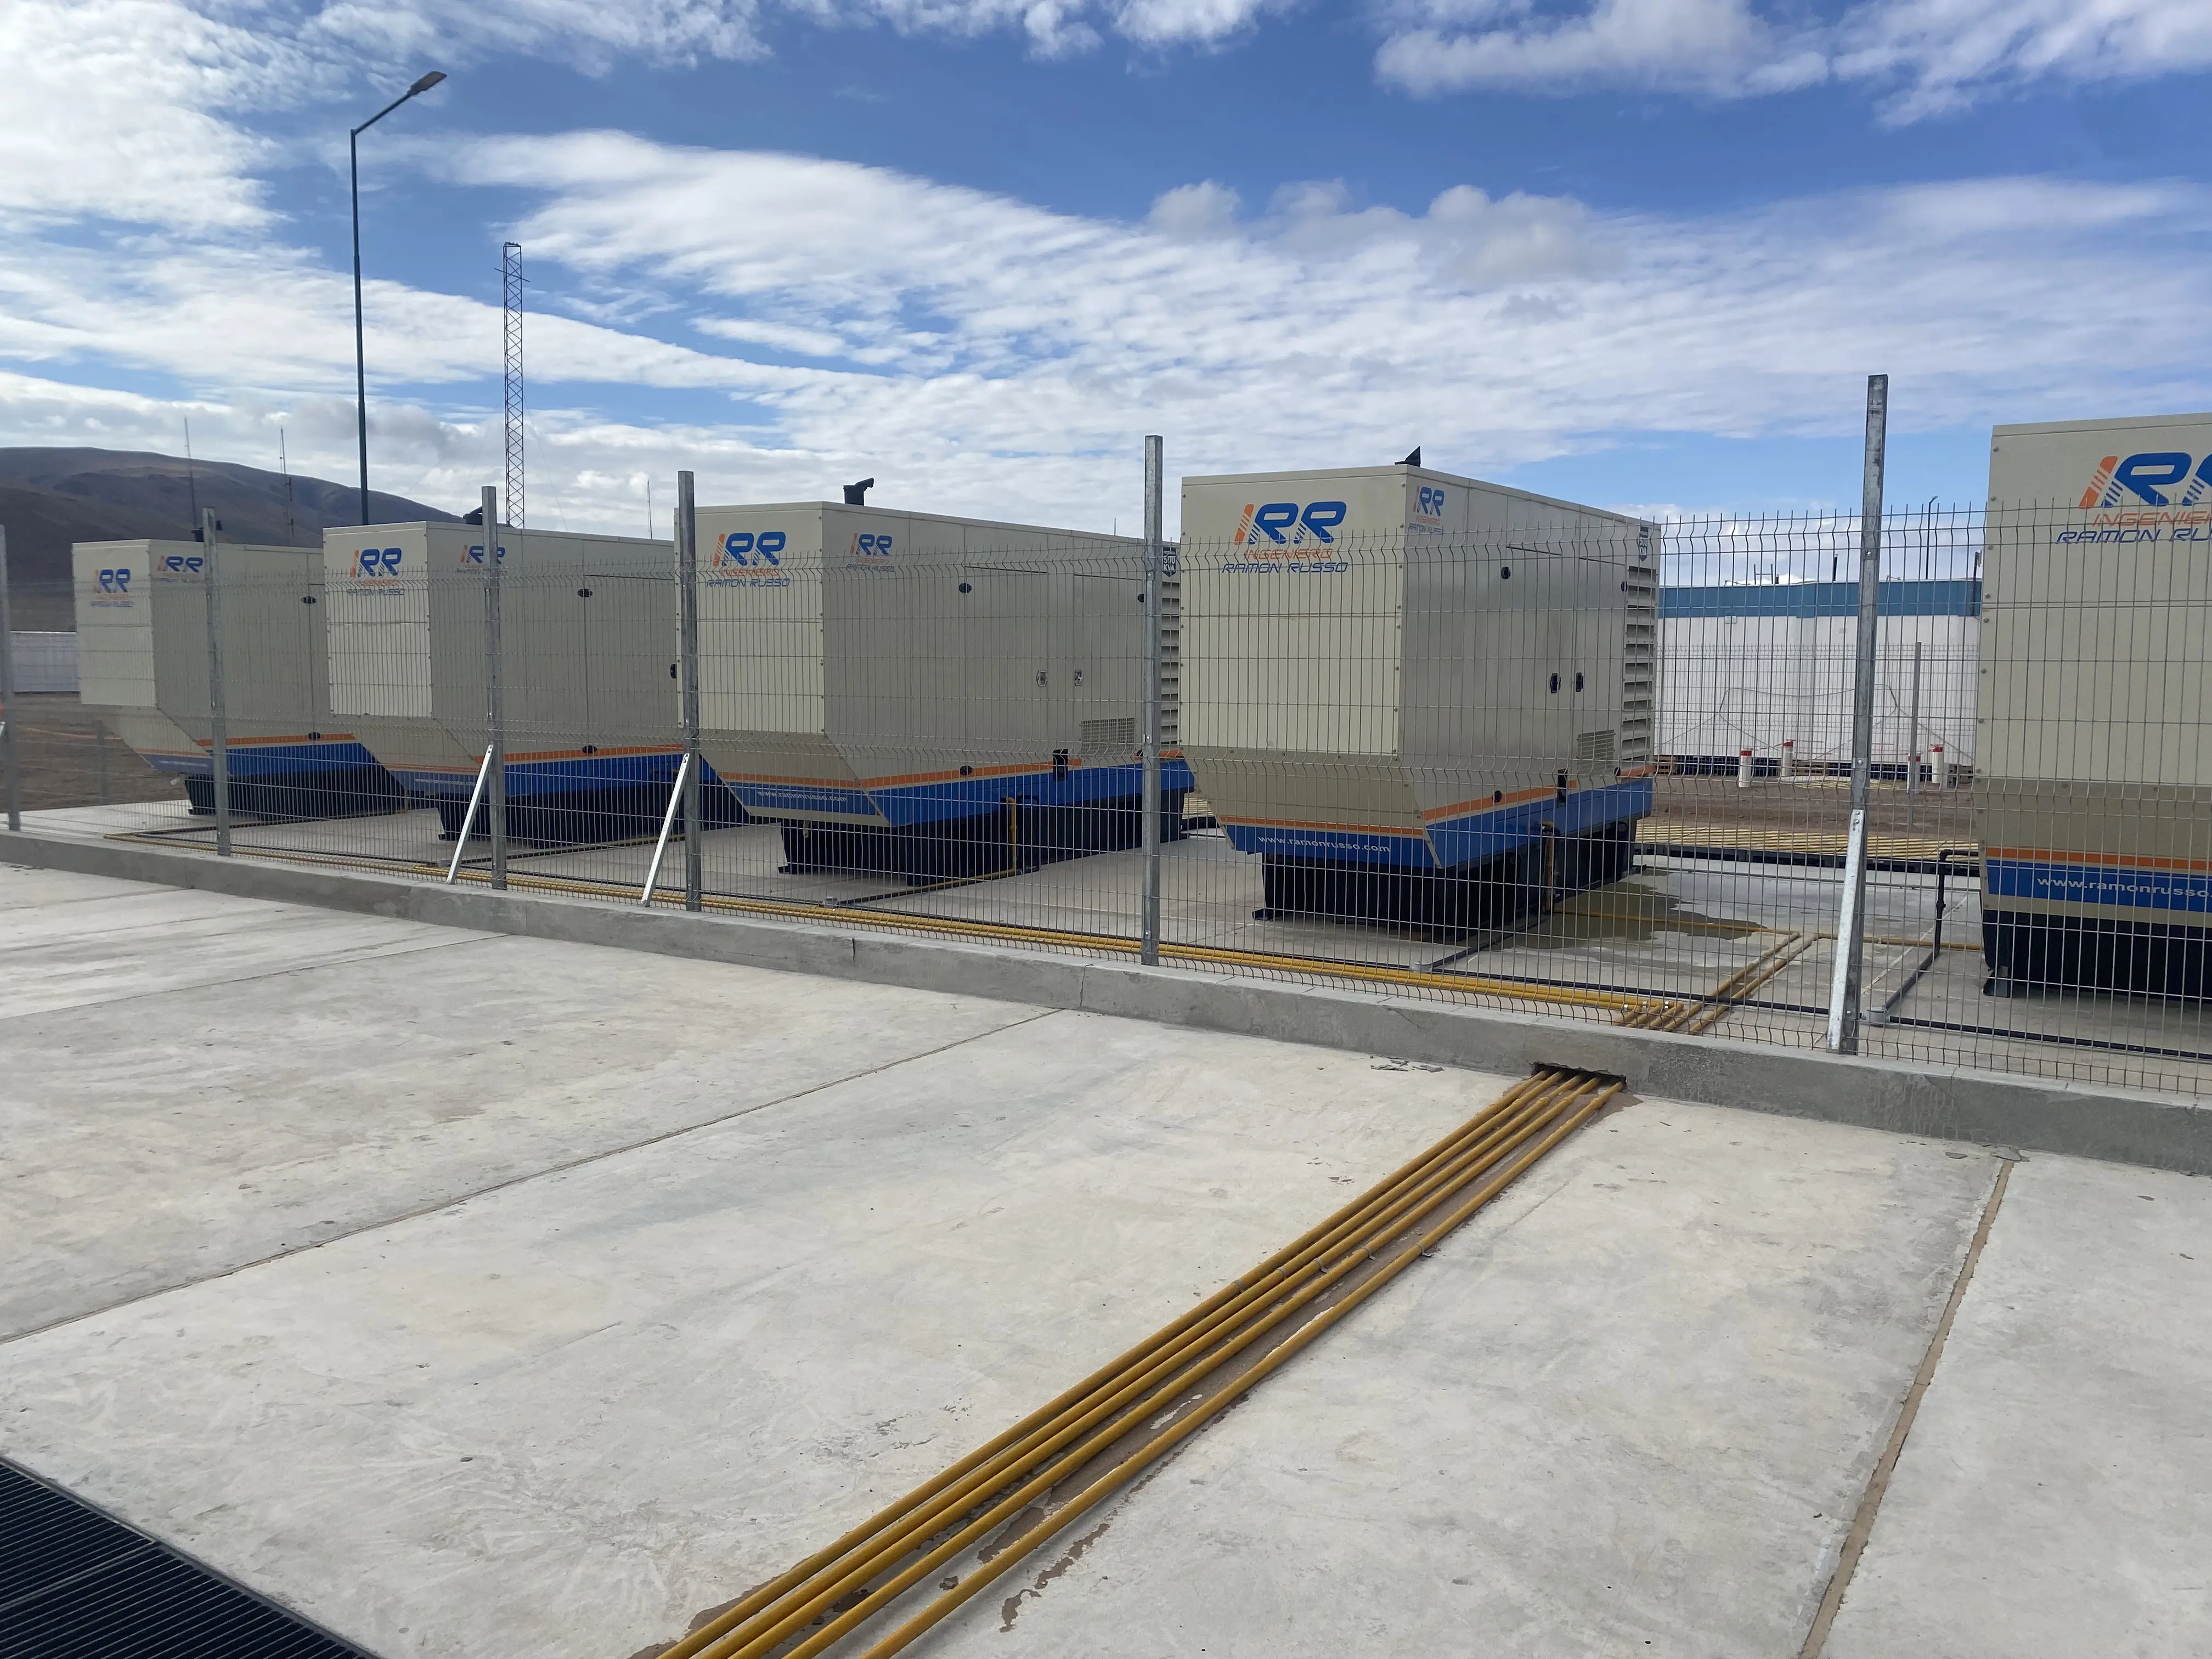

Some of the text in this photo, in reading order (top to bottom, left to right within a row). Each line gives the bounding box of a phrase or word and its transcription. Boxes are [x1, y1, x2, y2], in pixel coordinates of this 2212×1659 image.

[2056, 528, 2212, 544] RAMON RU
[1222, 562, 1348, 573] RAMON RUSSO
[707, 578, 790, 588] RAMON RUSSO
[1258, 837, 1390, 852] www.ramonrusso.com
